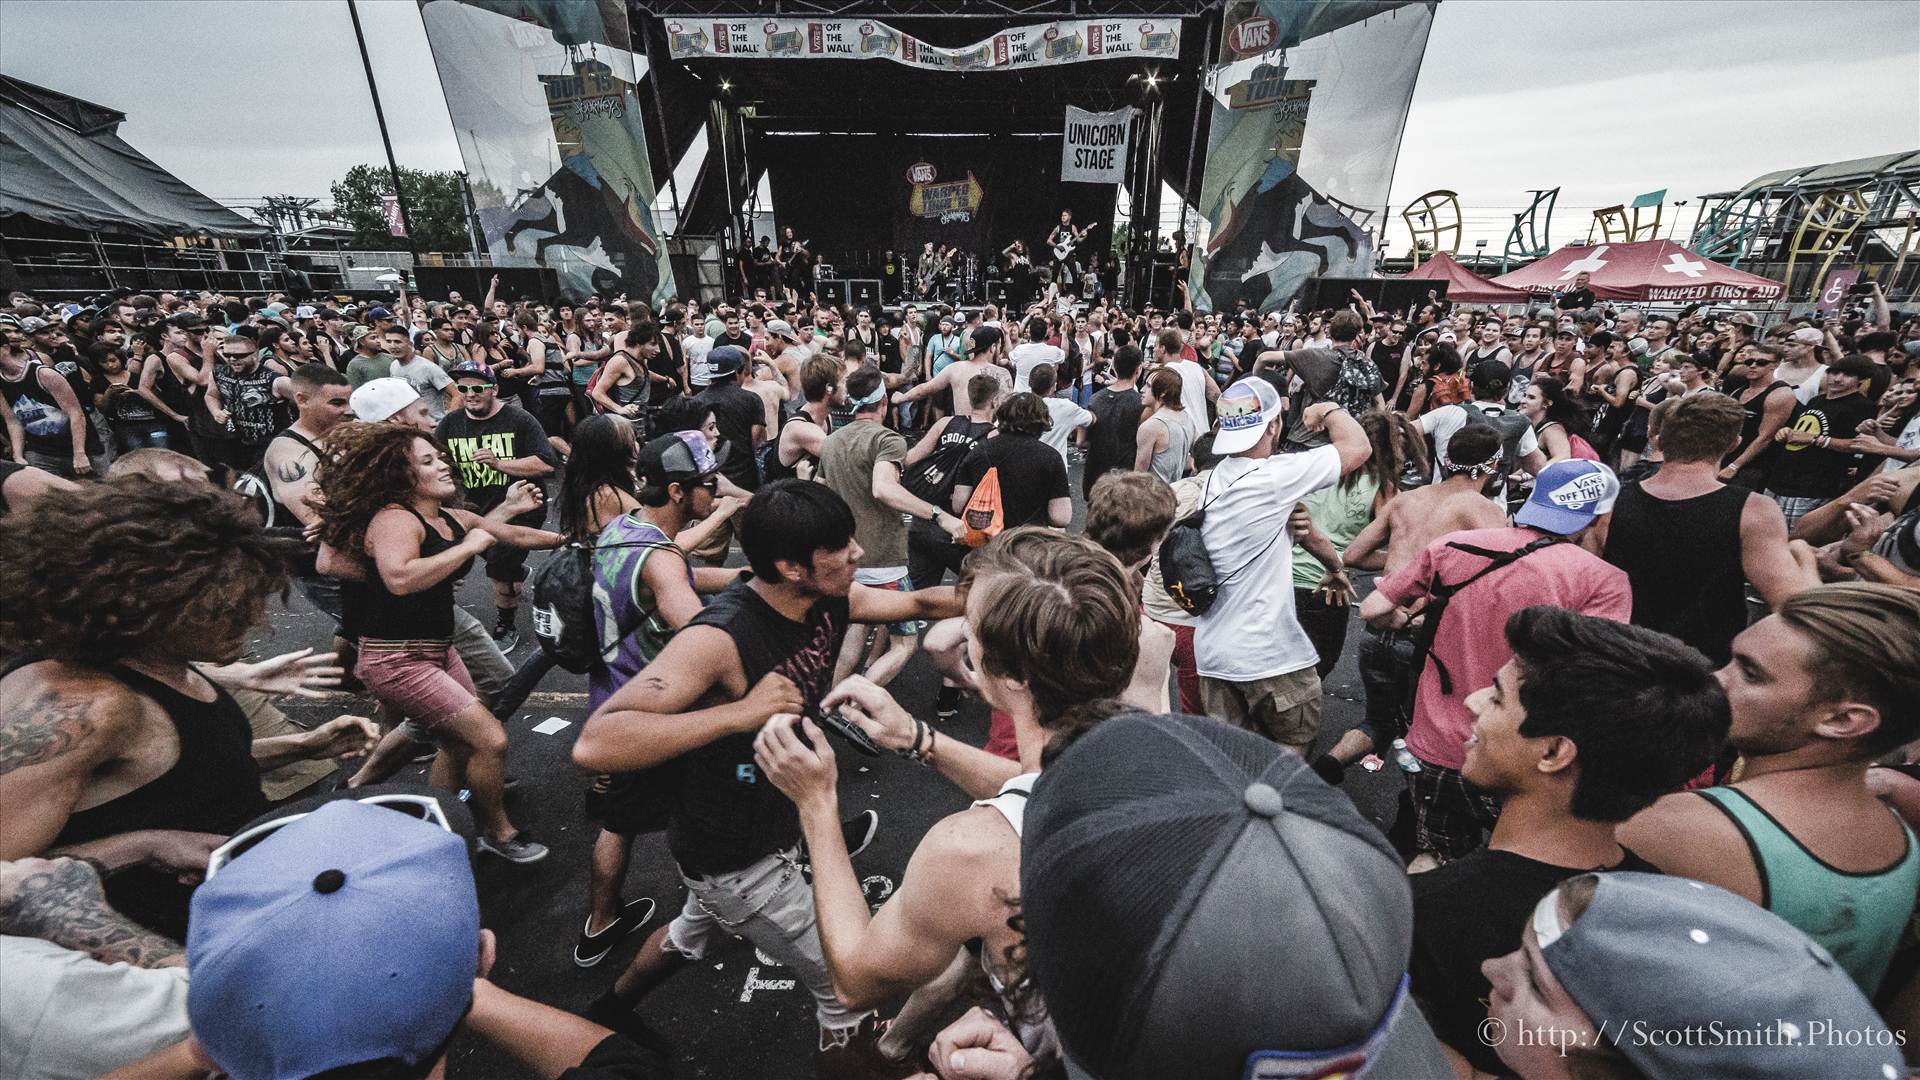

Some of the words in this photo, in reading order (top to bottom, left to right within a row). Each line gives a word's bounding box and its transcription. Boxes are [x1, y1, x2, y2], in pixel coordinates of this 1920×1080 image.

[731, 34, 748, 42] THE
[826, 34, 842, 42] THE
[1105, 34, 1122, 43] THE
[1237, 20, 1271, 50] VANS
[1012, 43, 1028, 52] THE
[1068, 123, 1126, 146] UNICORN
[1074, 148, 1116, 170] STAGE
[911, 165, 932, 183] VANS
[1648, 286, 1707, 300] WARPED
[1710, 284, 1749, 298] FIRST
[1752, 284, 1781, 298] AID
[447, 437, 480, 463] I'M
[481, 432, 515, 458] FAT
[1573, 473, 1603, 489] VANS
[1580, 484, 1602, 499] THE
